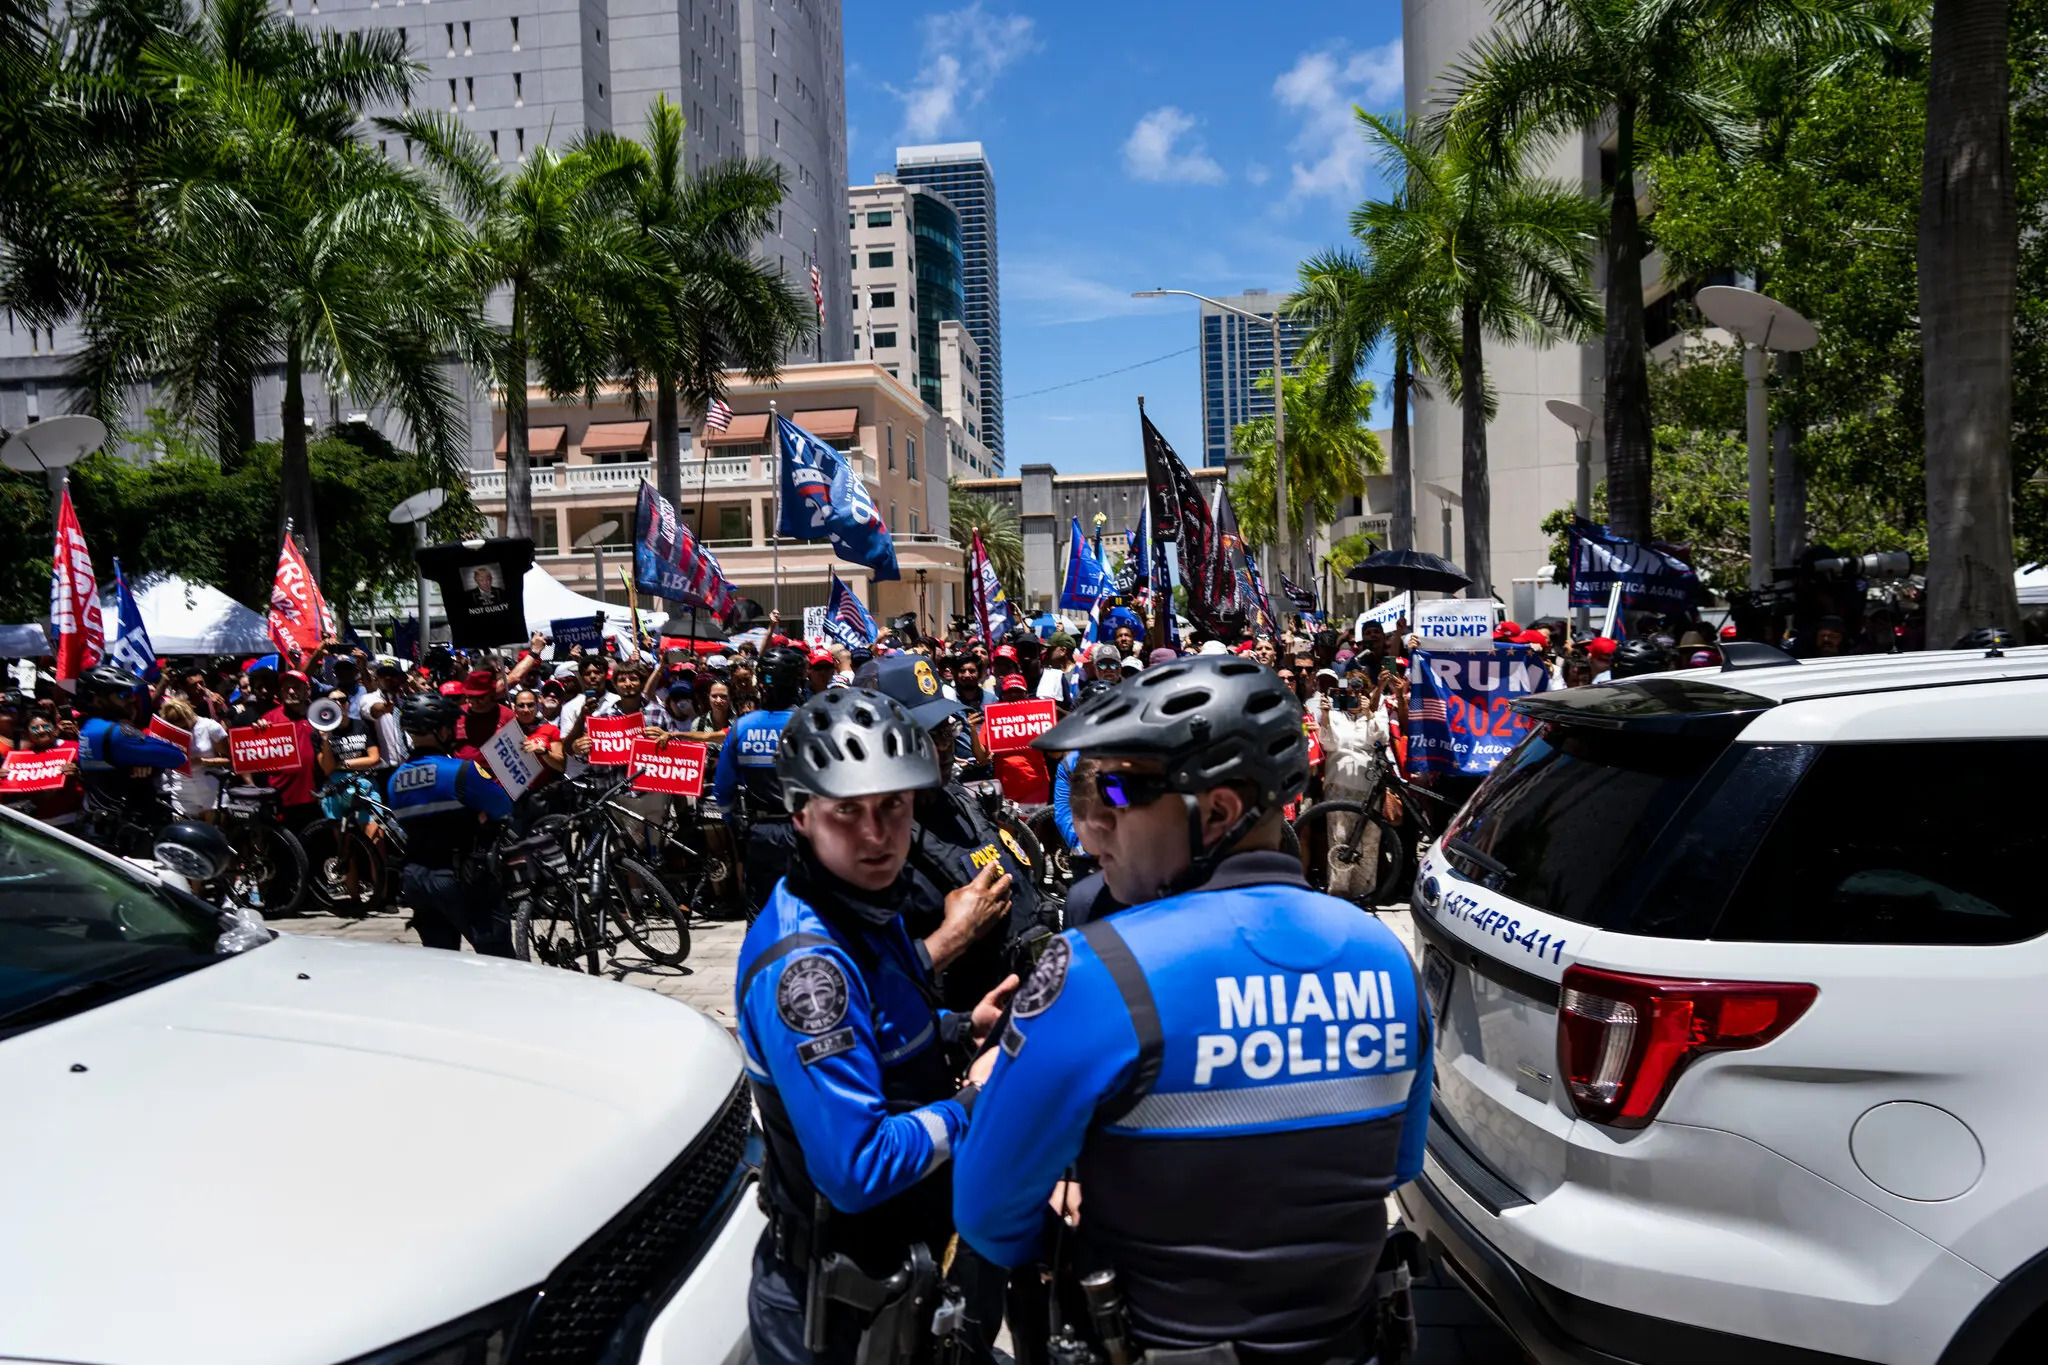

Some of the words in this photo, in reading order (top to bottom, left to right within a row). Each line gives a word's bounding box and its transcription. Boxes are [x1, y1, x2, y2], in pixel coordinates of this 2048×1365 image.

[1358, 519, 1387, 529] UNITED
[1574, 581, 1600, 592] SAVE
[468, 606, 485, 615] NOT
[485, 602, 509, 614] GUILTY
[556, 631, 599, 643] TRUMP
[1420, 624, 1488, 637] TRUMP
[996, 715, 1026, 725] STAND
[1026, 712, 1051, 722] WITH
[596, 730, 624, 738] STAND
[625, 727, 642, 736] WITH
[747, 729, 783, 741] MIA
[990, 720, 1053, 739] TRUMP
[240, 738, 268, 748] STAND
[268, 735, 293, 745] WITH
[505, 736, 520, 759] STAND
[742, 741, 779, 753] POL
[1409, 735, 1436, 748] The
[1439, 738, 1469, 753] rules
[1473, 741, 1512, 755] have
[235, 744, 295, 762] TRUMP
[15, 761, 44, 770] STAND
[45, 759, 67, 767] WITH
[494, 737, 526, 785] TRUMP
[641, 754, 672, 764] STAND
[674, 757, 699, 768] WITH
[7, 765, 63, 781] TRUMP
[633, 761, 699, 782] TRUMP
[1443, 890, 1566, 965] 1-877-4FPS-411
[1215, 970, 1396, 1030] MIAMI
[1193, 1022, 1407, 1085] POLICE
